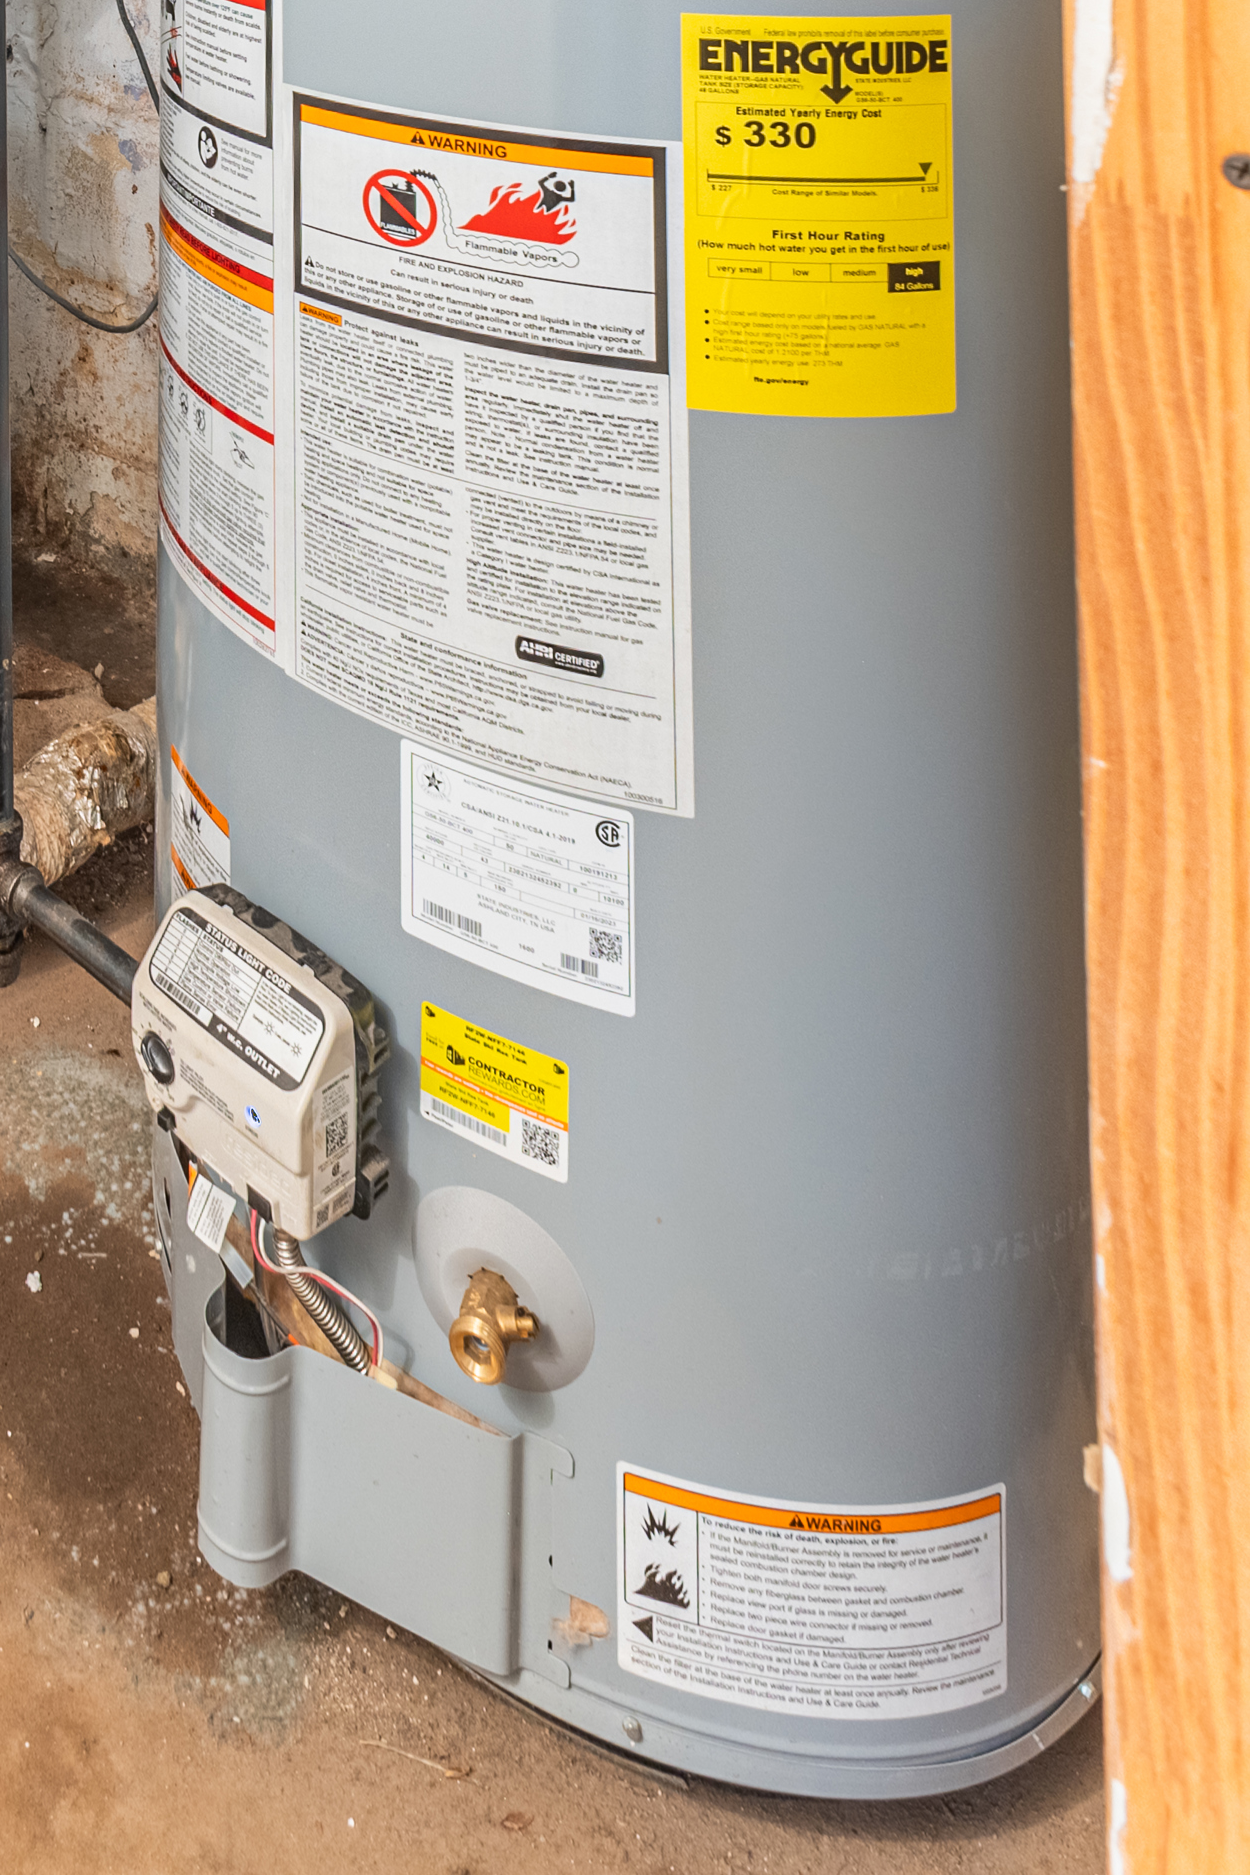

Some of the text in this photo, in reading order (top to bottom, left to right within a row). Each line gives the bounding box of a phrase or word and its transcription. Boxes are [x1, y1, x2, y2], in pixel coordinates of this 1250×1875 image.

[698, 38, 948, 75] ENERGYGUIDE
[736, 107, 882, 119] Estimated Yearly Energy Cost
[715, 120, 817, 149] $ 330
[427, 135, 508, 159] WARNING
[772, 230, 885, 242] First Hour Rating
[465, 240, 558, 263] Flammable Vapors
[697, 239, 950, 255] (How much hot water you get in the first hour of use)
[398, 256, 523, 287] FIRE AND EXPLOSION HAZARD
[716, 265, 762, 275] very small
[792, 268, 809, 277] low
[843, 269, 876, 277] medium
[905, 267, 923, 277] high
[390, 269, 405, 279] Can
[407, 272, 430, 284] result
[431, 277, 439, 286] in
[441, 280, 470, 292] serious
[472, 288, 496, 299] injury
[510, 295, 533, 304] death
[907, 282, 934, 290] Gallons
[308, 308, 340, 324] WARNING
[344, 320, 419, 347] Protect against leaks
[530, 850, 563, 866] NATURAL
[202, 934, 223, 952] STATUS
[205, 924, 292, 993] STATUS LIGHT CODE
[245, 1046, 280, 1077] OUTLET
[468, 1056, 545, 1095] CONTRACTOR
[468, 1066, 545, 1105] REWARDS.COM
[701, 1516, 713, 1526] To
[715, 1521, 745, 1532] reduce
[748, 1527, 762, 1536] the
[765, 1530, 781, 1539] risk
[795, 1534, 823, 1543] death,
[825, 1537, 869, 1545] explosion,
[806, 1517, 882, 1533] WARNING
